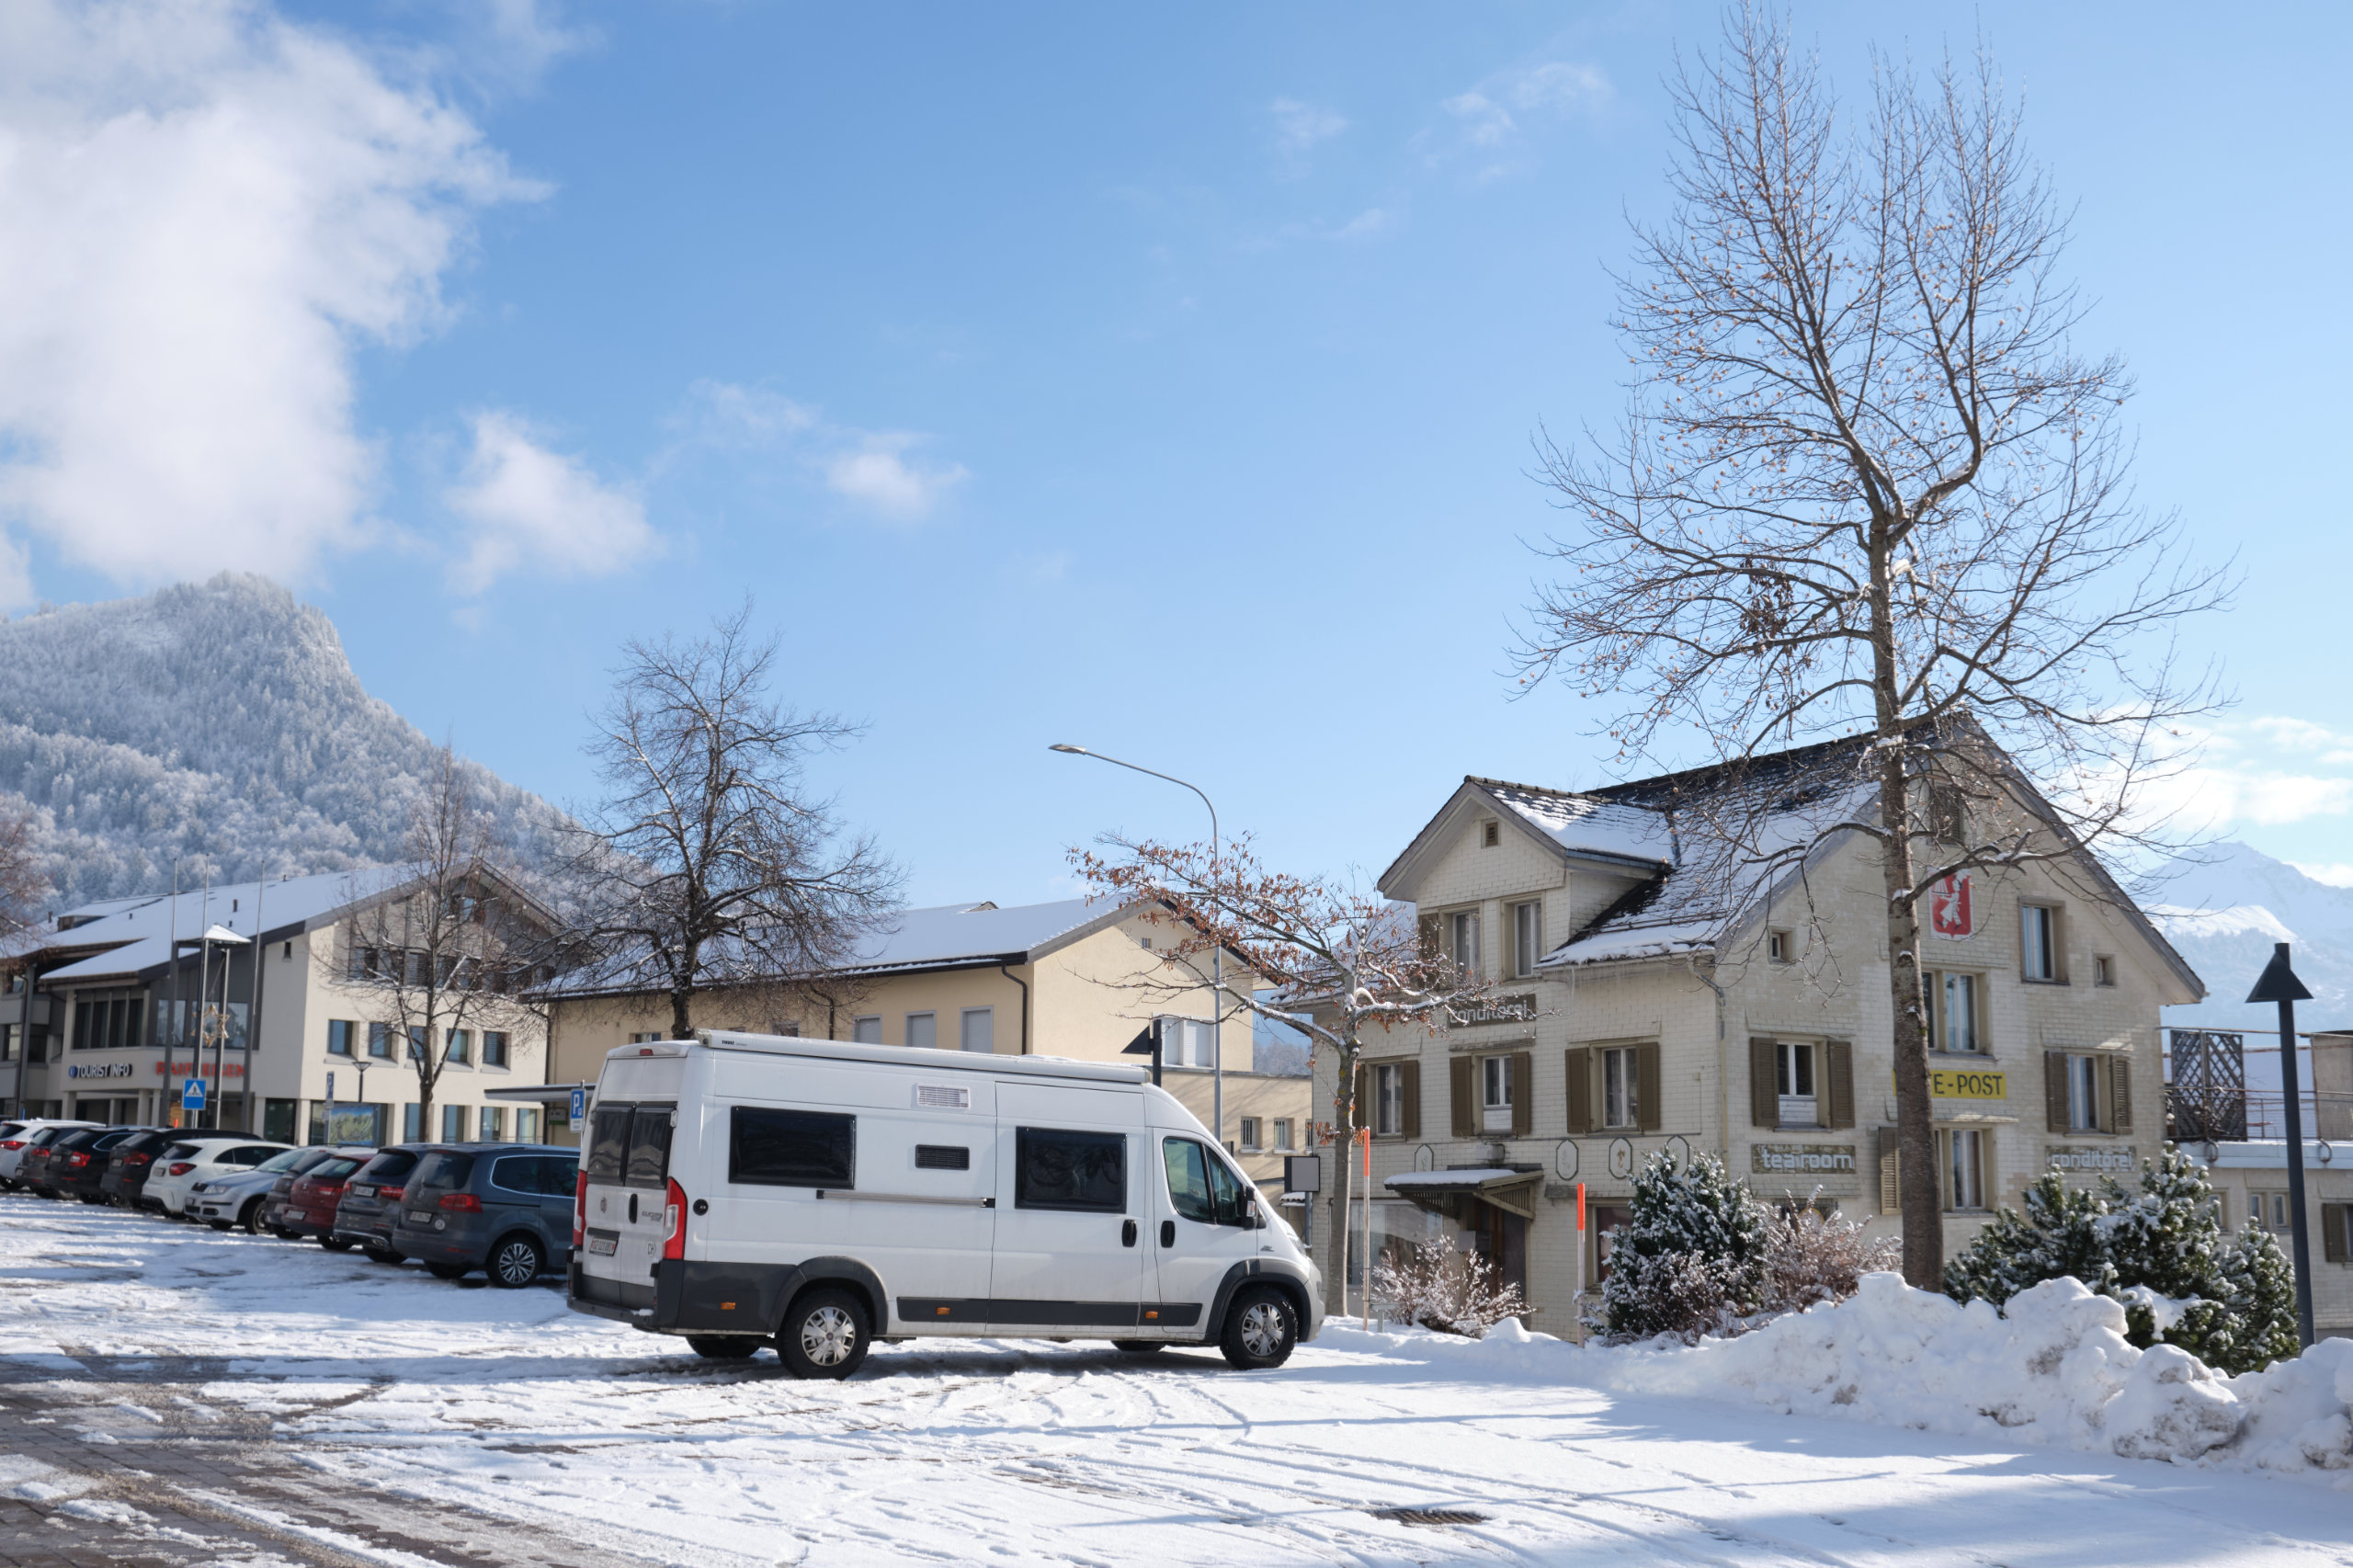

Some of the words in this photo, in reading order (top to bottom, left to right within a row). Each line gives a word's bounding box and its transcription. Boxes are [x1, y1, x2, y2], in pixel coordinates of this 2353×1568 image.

[77, 1063, 108, 1078] TOURIST
[109, 1062, 131, 1077] INFO
[573, 1094, 580, 1115] P
[2051, 1150, 2132, 1168] conditorei
